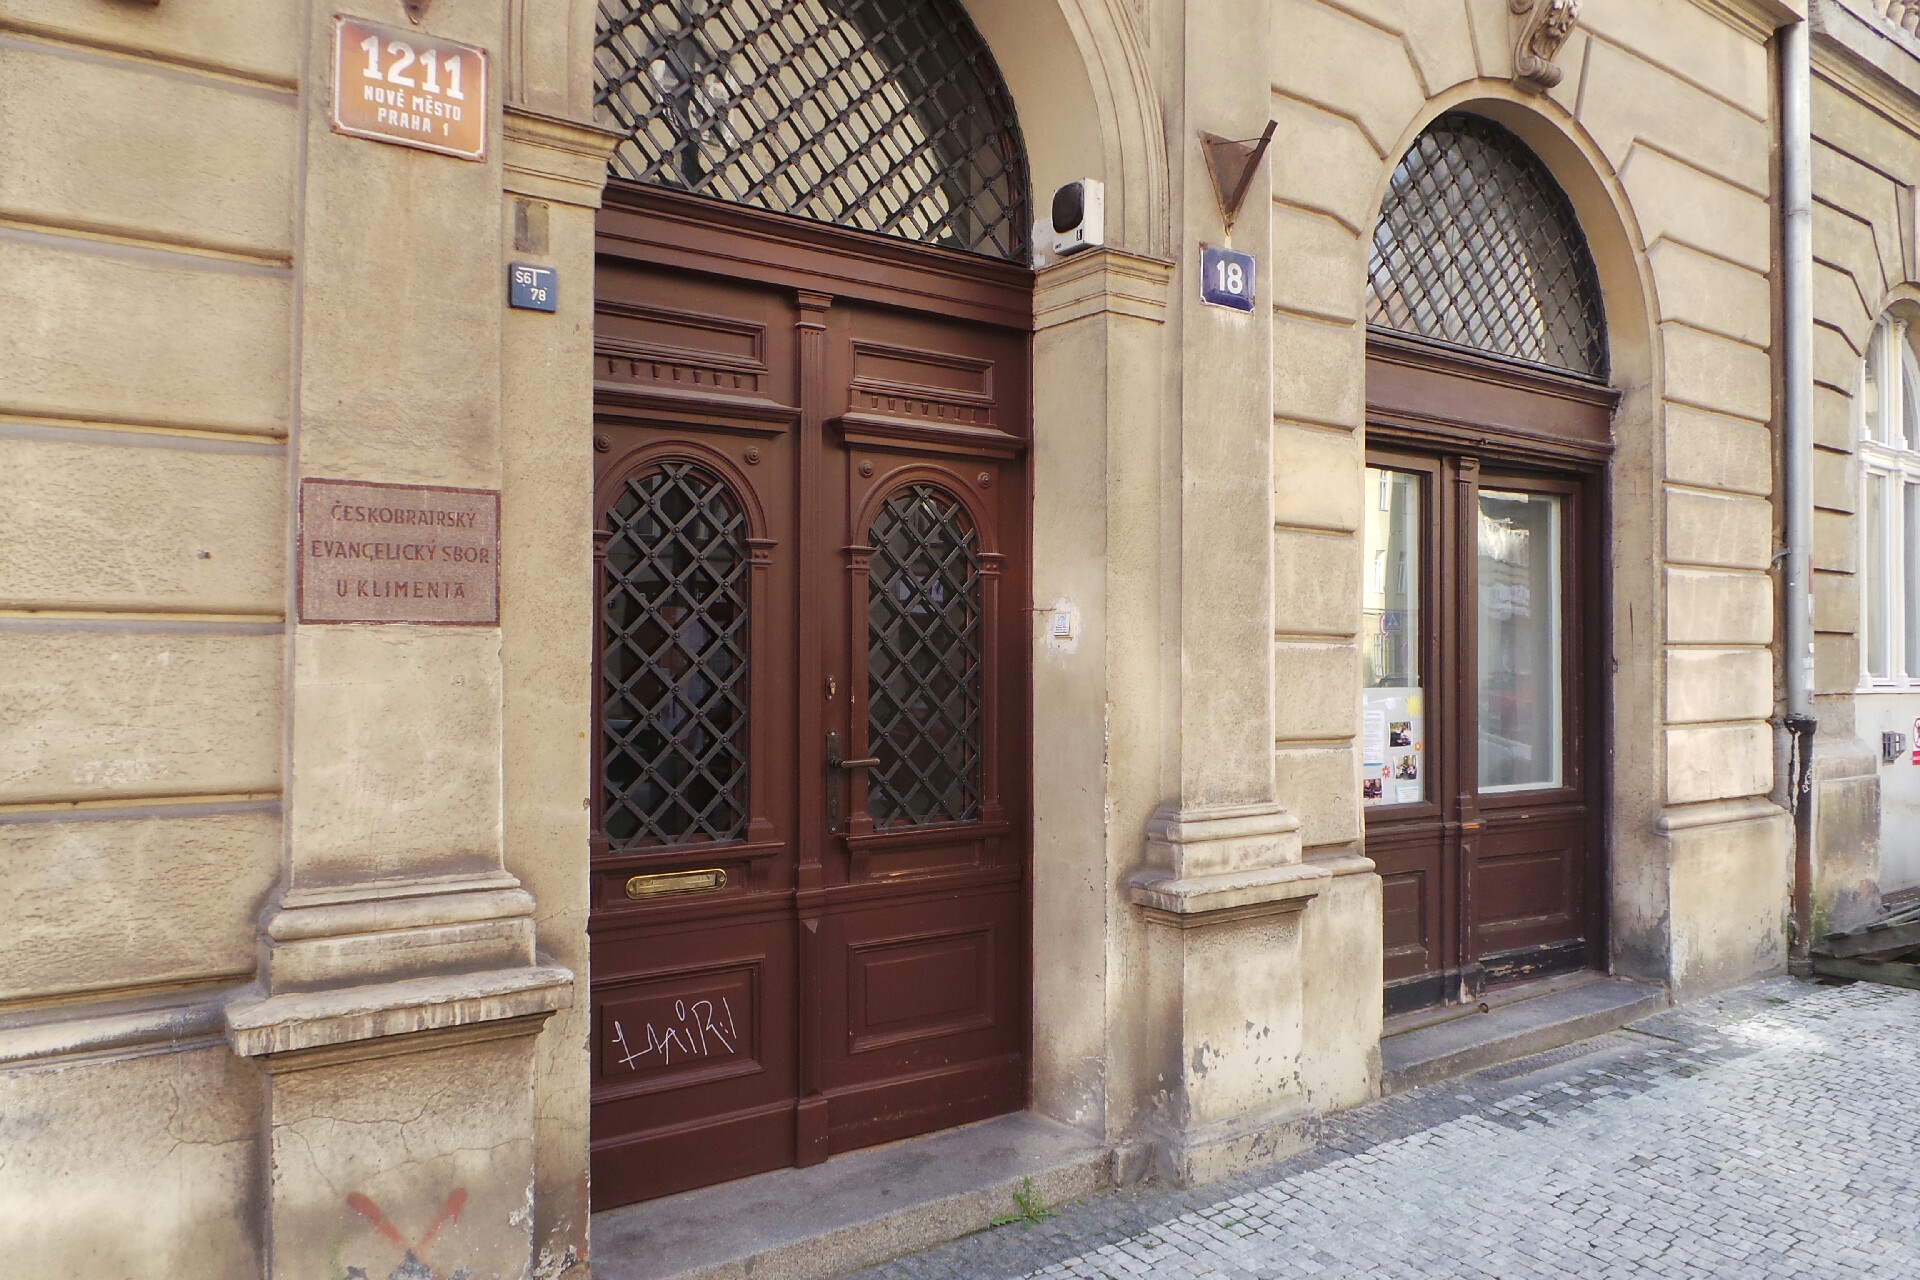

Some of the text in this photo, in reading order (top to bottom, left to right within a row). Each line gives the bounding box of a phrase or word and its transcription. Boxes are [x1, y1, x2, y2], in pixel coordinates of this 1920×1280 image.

[360, 35, 464, 100] 1211
[364, 85, 462, 121] NOVÉ MĚSTO
[378, 107, 450, 136] PRAHA 1
[1216, 260, 1243, 294] 18
[442, 546, 490, 563] SBOR
[337, 579, 466, 598] U KLIMENTA
